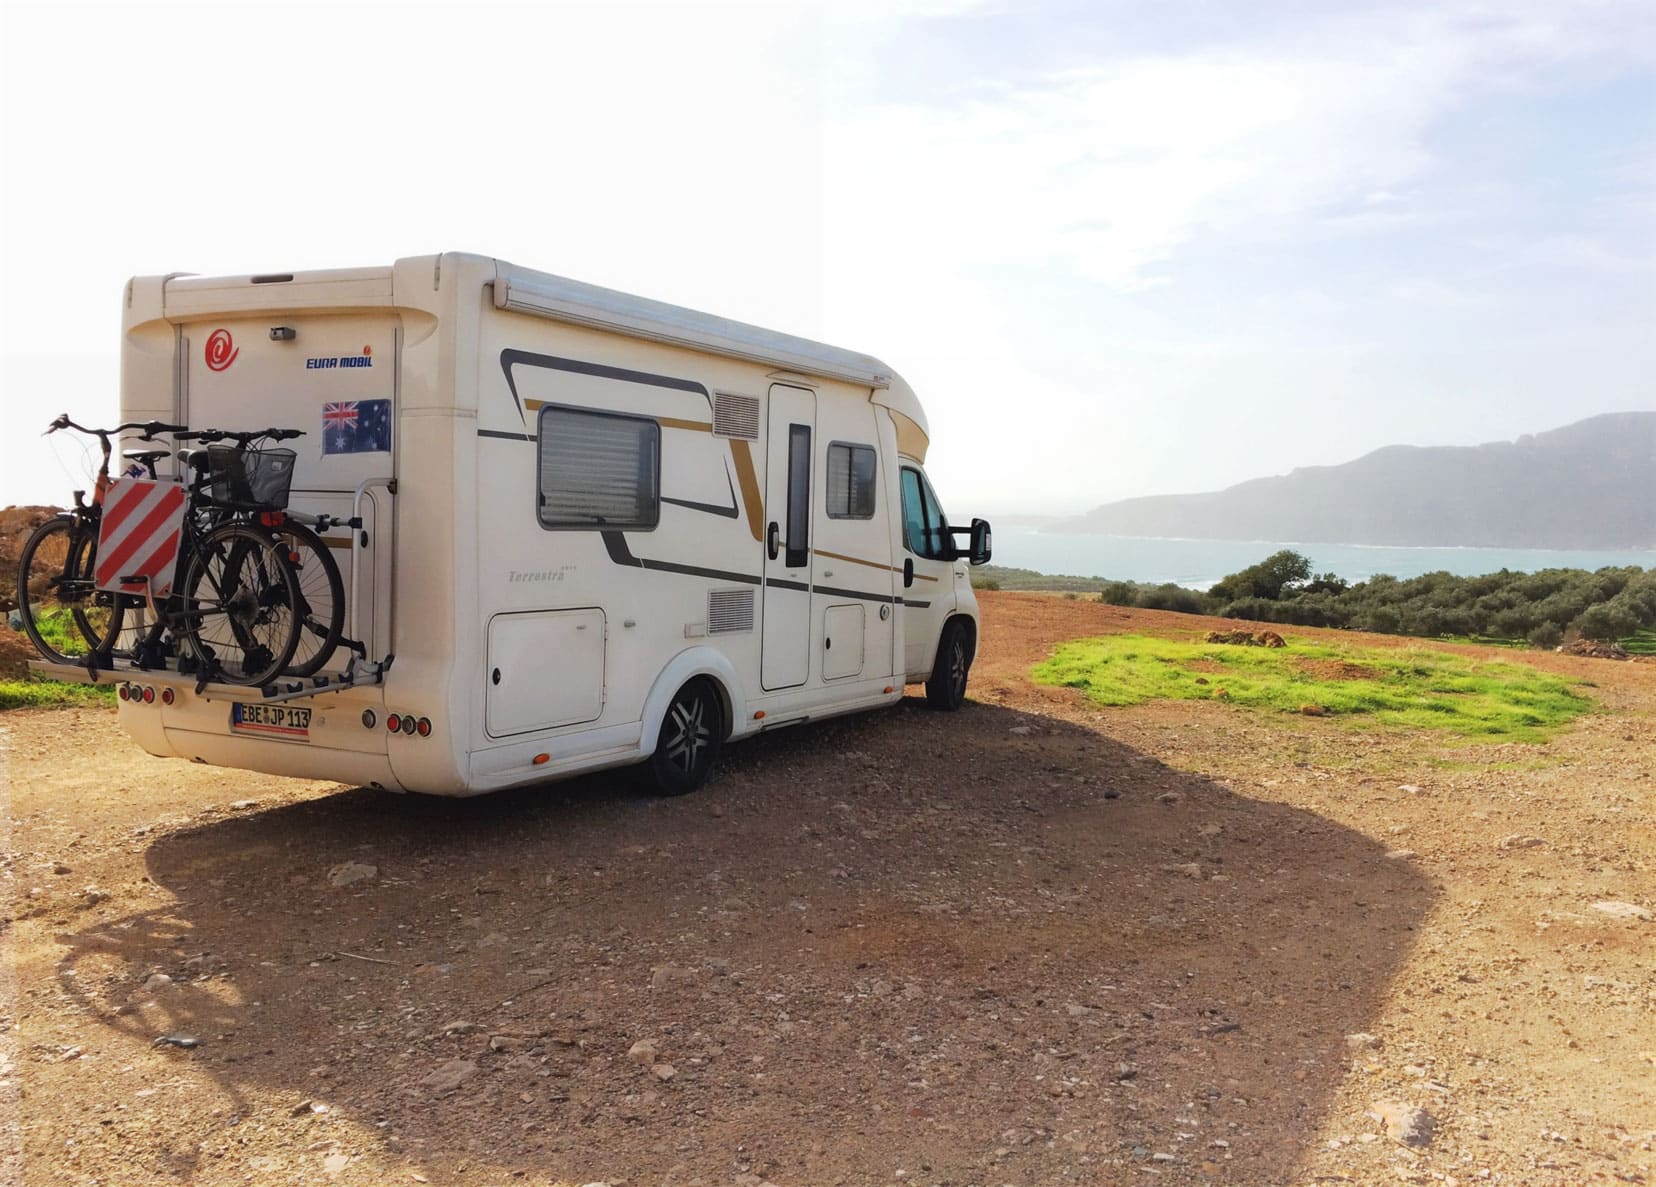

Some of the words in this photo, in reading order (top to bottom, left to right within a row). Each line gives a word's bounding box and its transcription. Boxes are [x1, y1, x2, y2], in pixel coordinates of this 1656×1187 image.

[306, 358, 337, 369] EURA
[340, 356, 373, 368] MOBIL
[241, 705, 262, 723] EBE
[271, 708, 284, 725] JP
[288, 709, 309, 728] 113
